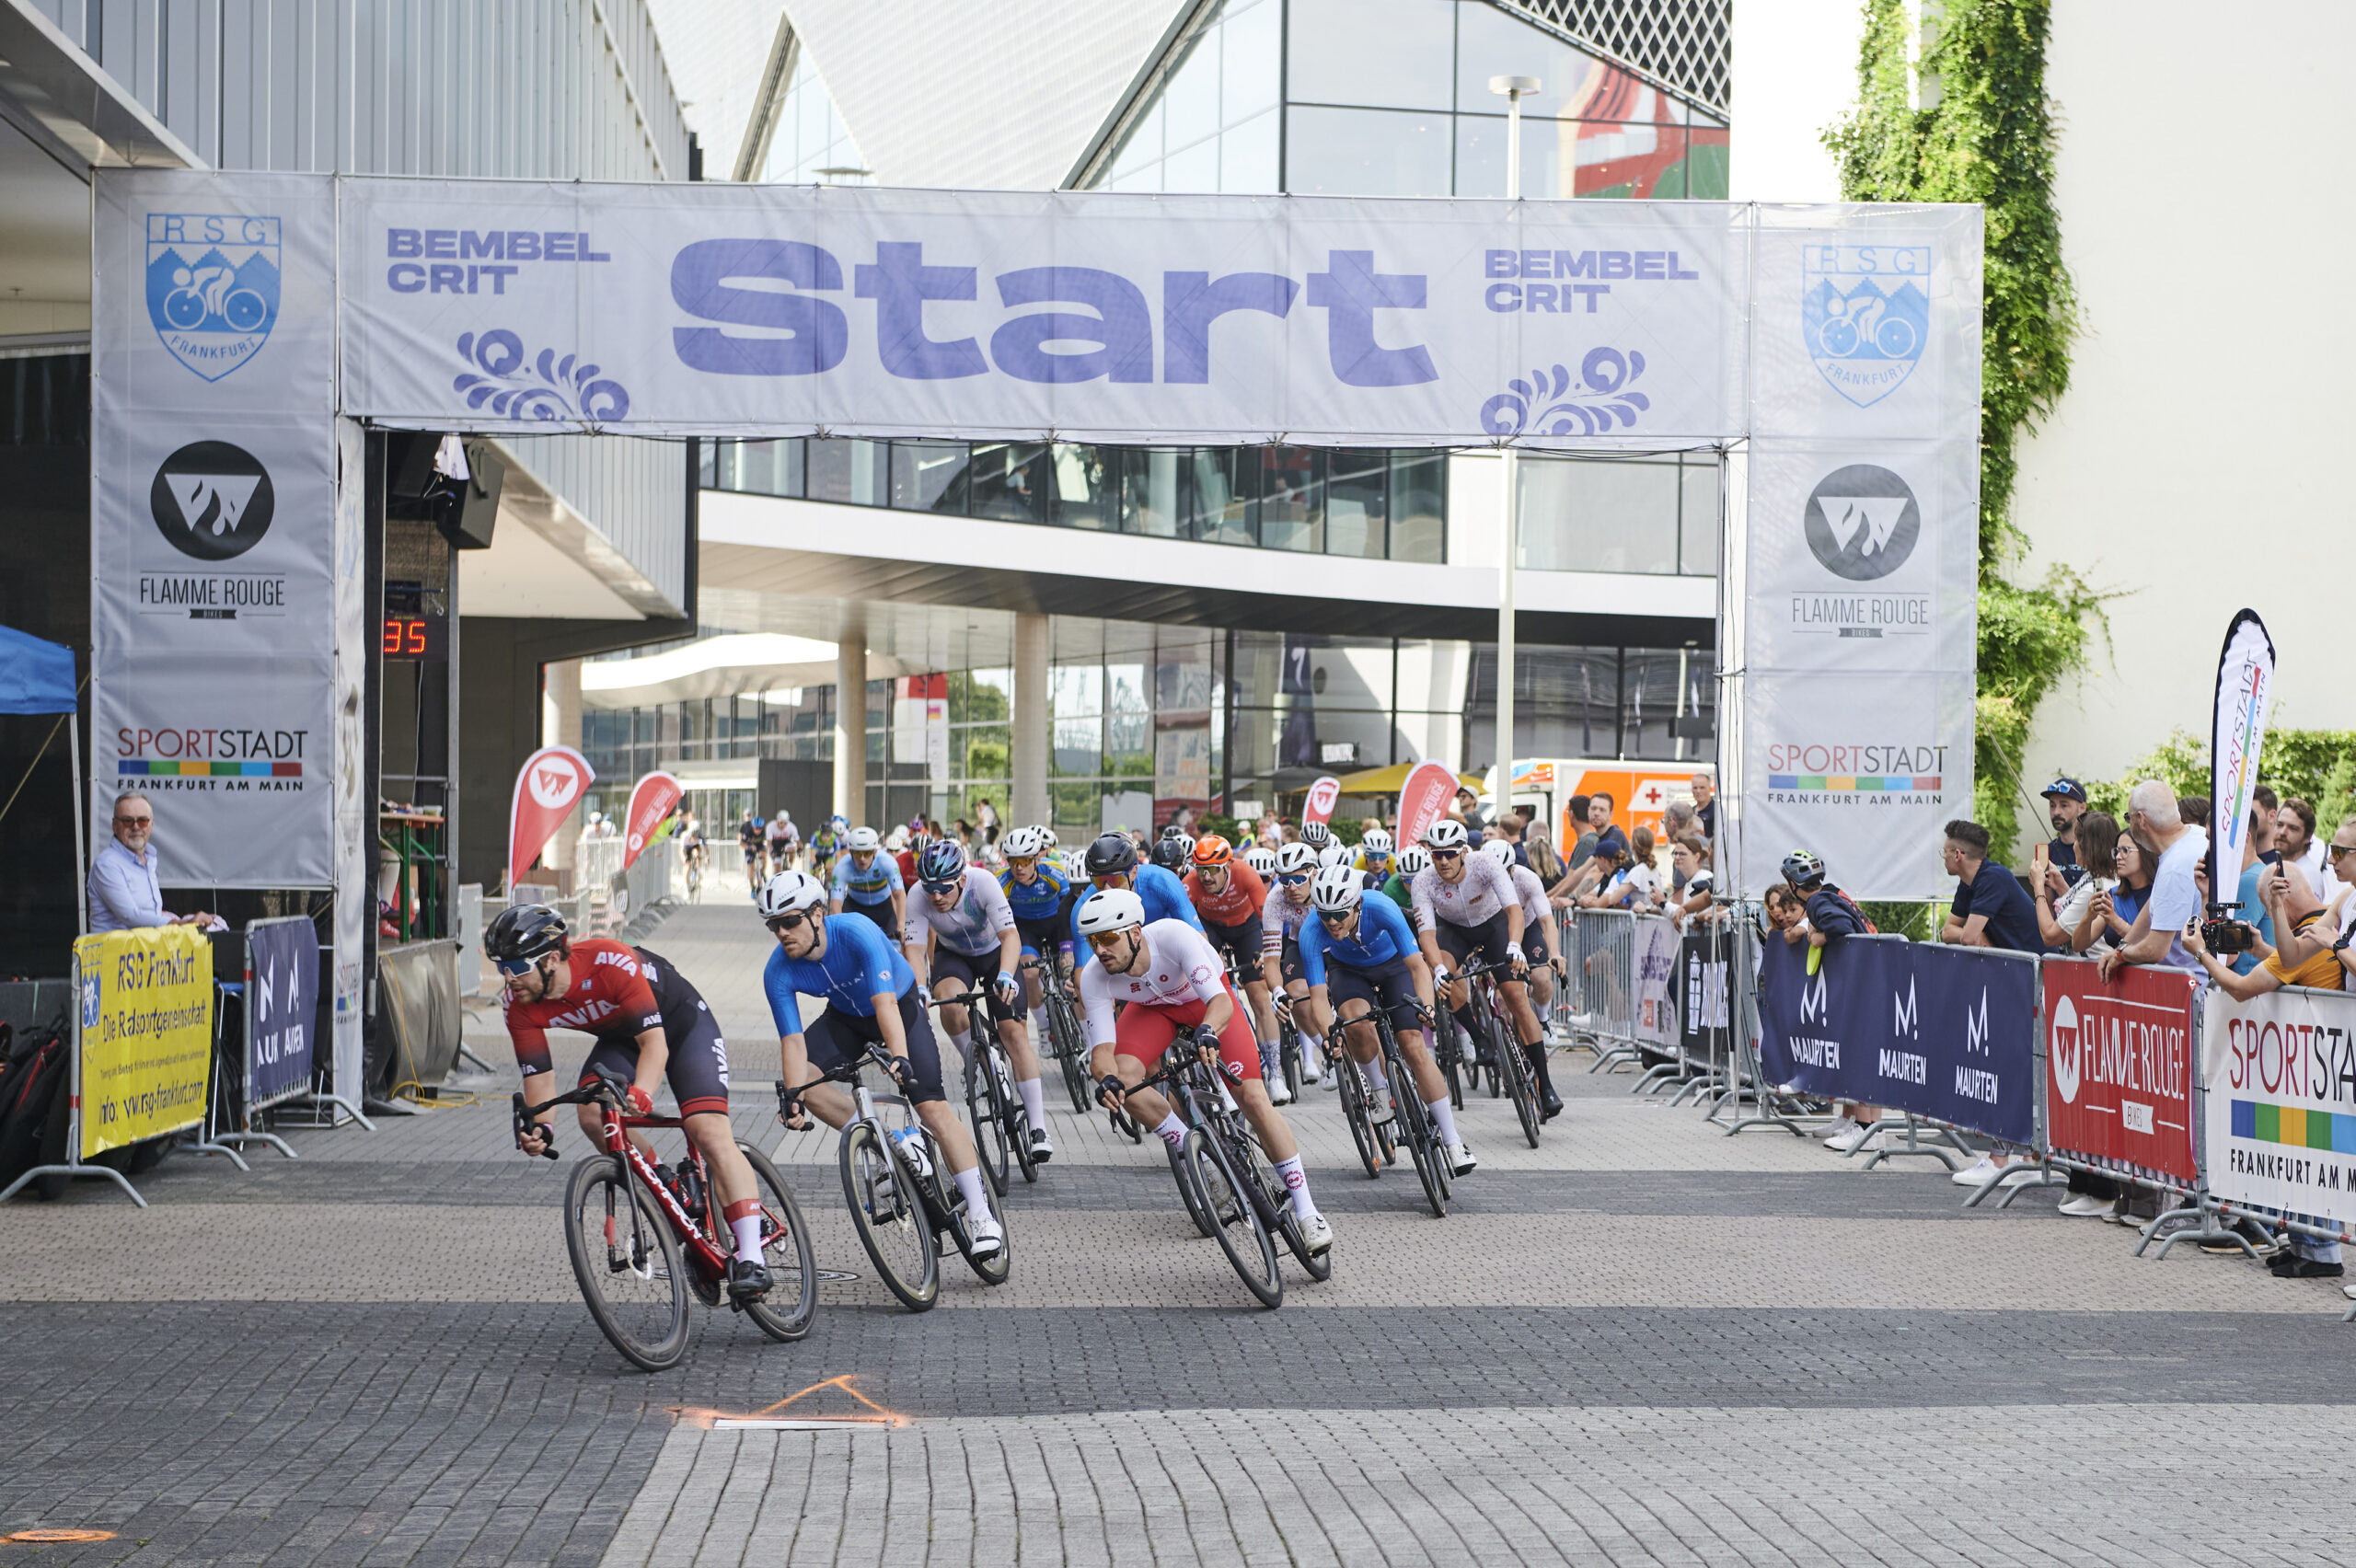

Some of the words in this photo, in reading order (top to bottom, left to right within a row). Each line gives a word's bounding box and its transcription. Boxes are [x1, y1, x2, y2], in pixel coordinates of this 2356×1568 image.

[387, 227, 610, 262] BEMBEL
[387, 262, 518, 295] CRIT
[1484, 248, 1700, 281] BEMBEL
[670, 237, 1439, 388] Start
[1484, 282, 1611, 314] CRIT
[169, 334, 256, 359] FRANKFURT
[1825, 363, 1906, 386] FRANKFURT
[140, 578, 218, 605] FLAMME
[224, 579, 284, 605] ROUGE
[202, 609, 224, 619] BIKES
[1792, 598, 1866, 624] FLAMME
[1871, 599, 1929, 625] ROUGE
[383, 620, 426, 652] 35
[1851, 628, 1871, 638] BIKES
[117, 728, 308, 758] SPORTSTADT
[1767, 744, 1948, 773] SPORTSTADT
[117, 778, 216, 791] FRANKFURT
[225, 780, 249, 791] AM
[259, 781, 304, 792] MAIN
[1767, 793, 1861, 805] FRANKFURT
[1869, 794, 1892, 805] AM
[1900, 795, 1942, 805] MAIN
[117, 951, 144, 993] RSG
[146, 949, 195, 989] Frankfurt
[103, 1012, 117, 1043] Die
[1789, 1036, 1840, 1070] MAURTEN
[1878, 1048, 1927, 1086] MAURTEN
[2140, 1021, 2185, 1101] ROUGE
[1955, 1065, 1999, 1105] MAURTEN
[2230, 1149, 2311, 1185] FRANKFURT
[2317, 1163, 2339, 1191] AM
